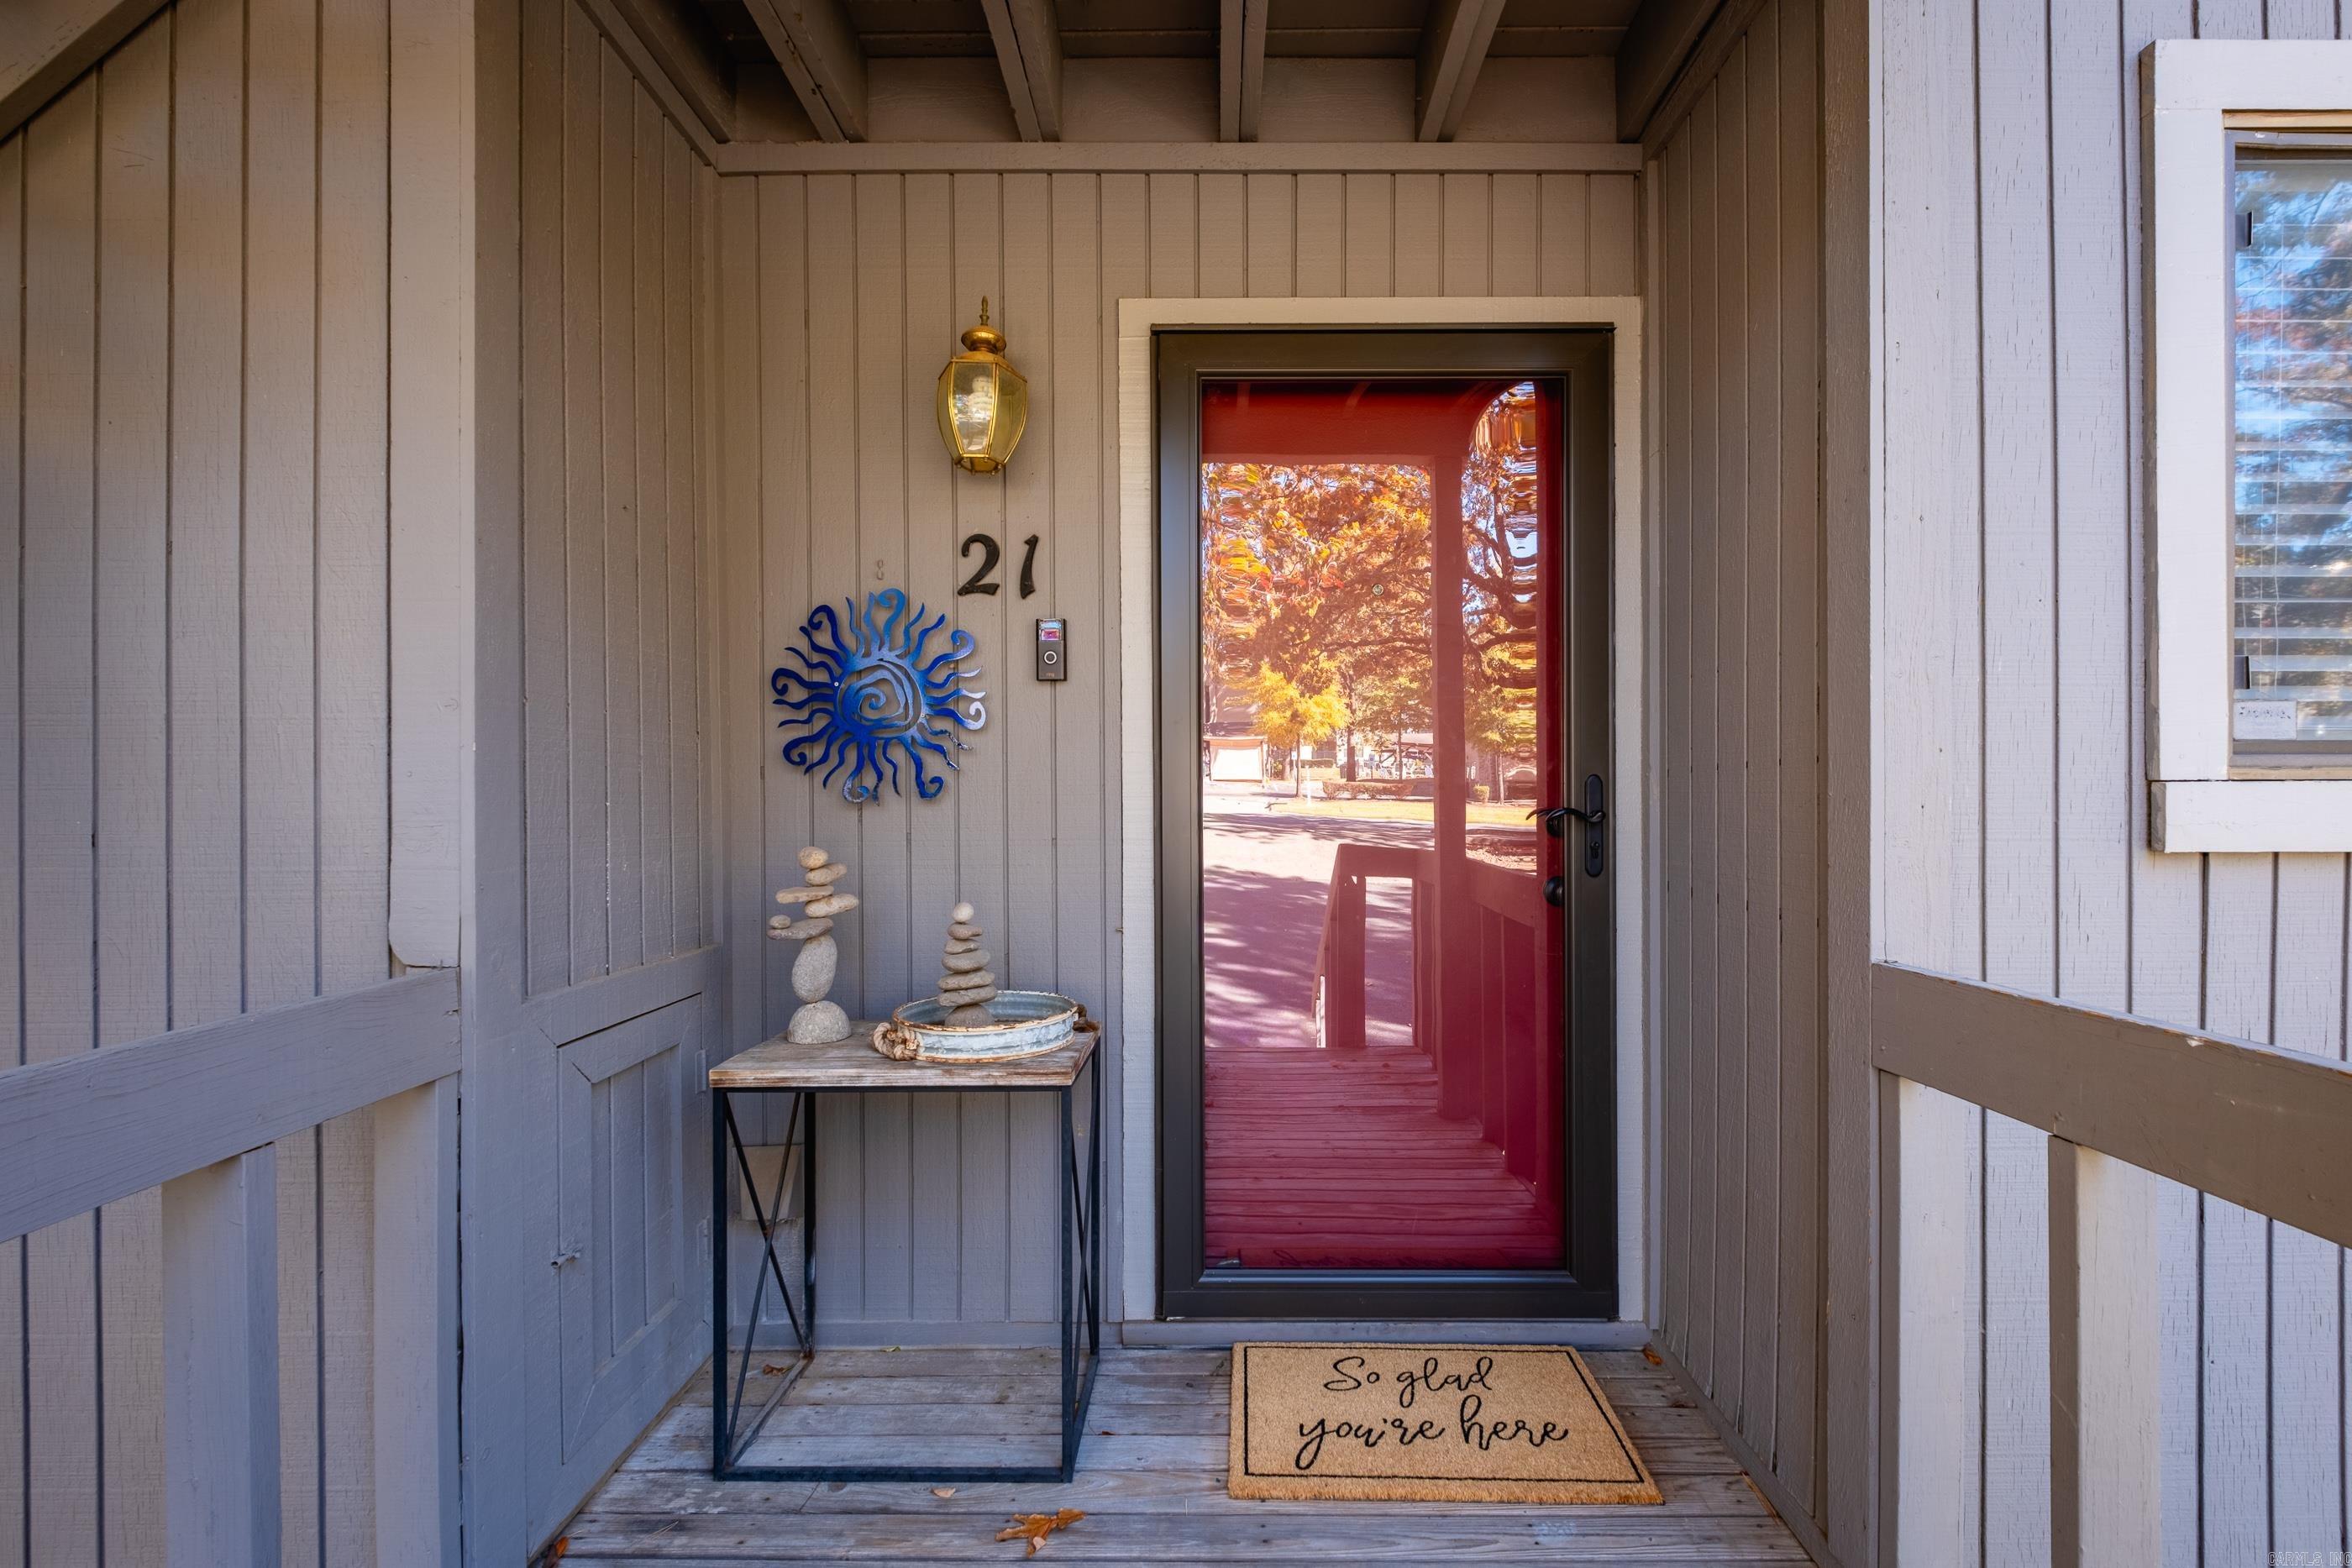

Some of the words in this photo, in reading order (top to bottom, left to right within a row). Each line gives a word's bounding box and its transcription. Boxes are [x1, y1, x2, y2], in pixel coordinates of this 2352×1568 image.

[958, 534, 1039, 599] 21
[1324, 1356, 1380, 1391] So
[1397, 1356, 1494, 1408] glad
[1294, 1417, 1446, 1470] you're
[1460, 1394, 1568, 1450] here
